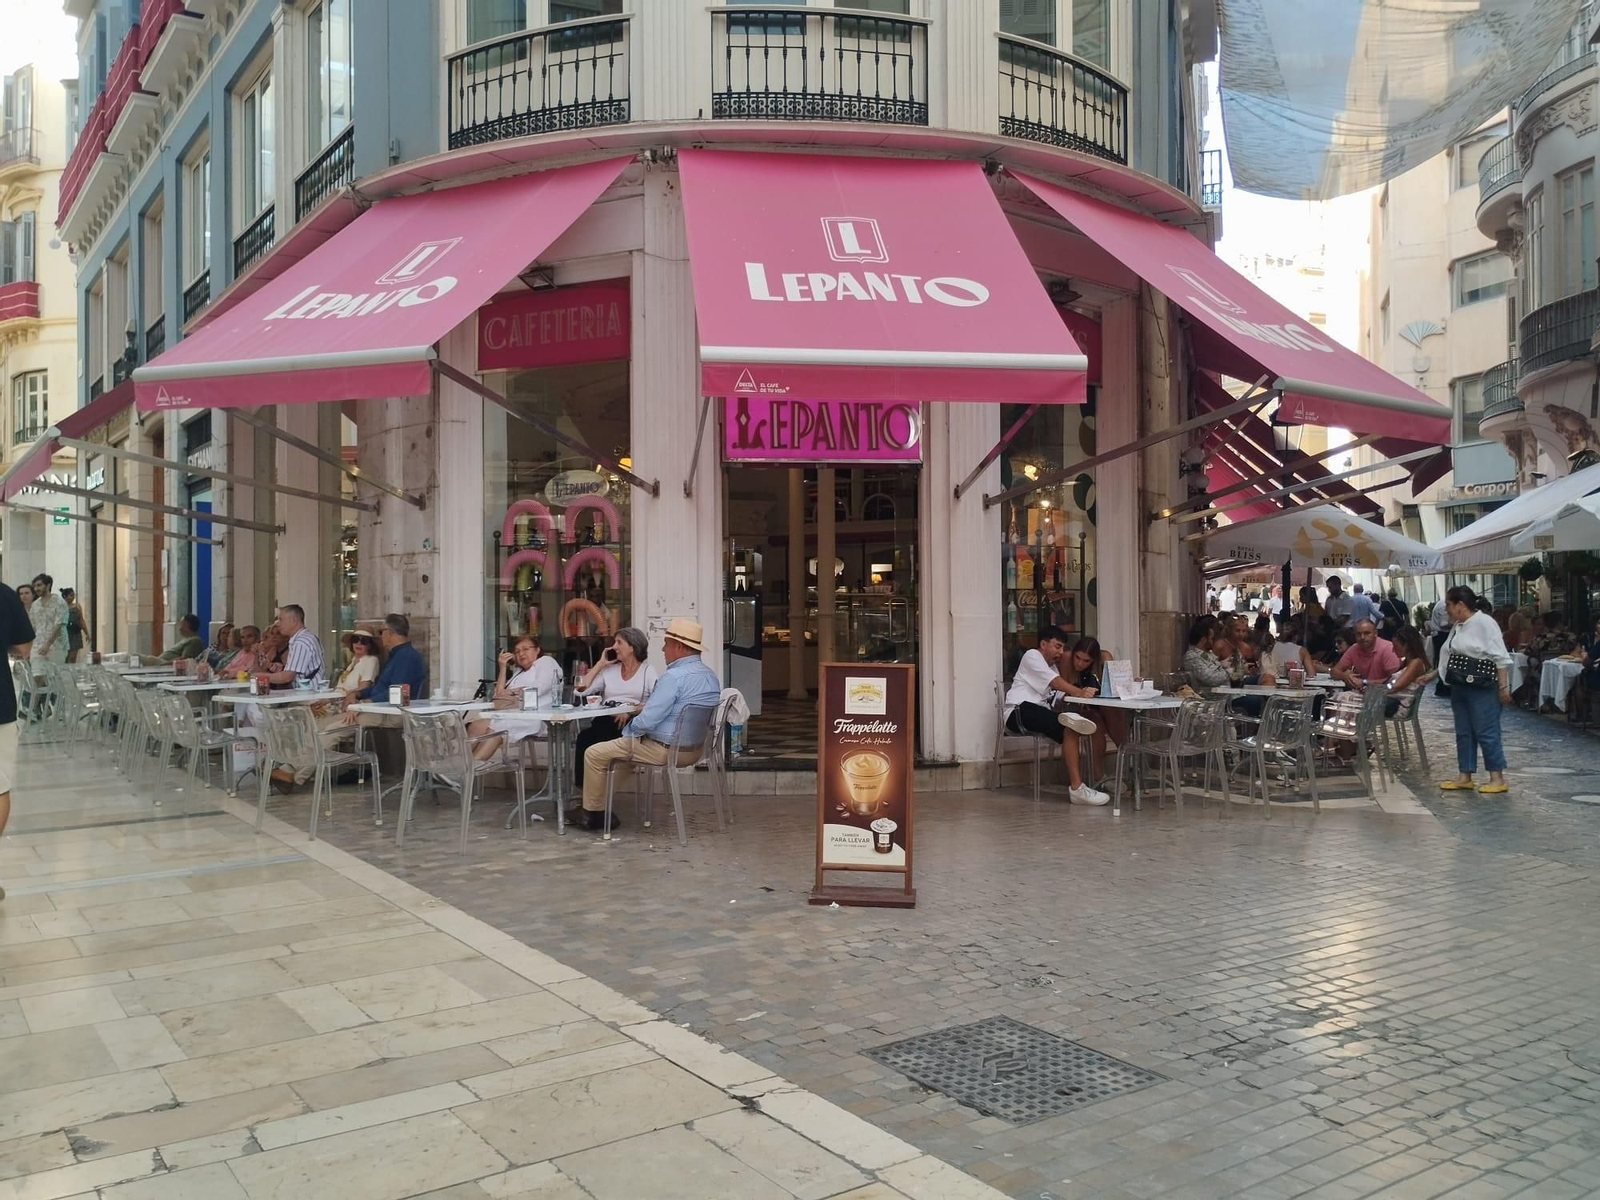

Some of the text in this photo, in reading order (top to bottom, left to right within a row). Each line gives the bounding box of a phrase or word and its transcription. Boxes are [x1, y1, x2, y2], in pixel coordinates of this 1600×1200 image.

[262, 276, 459, 321] LEPANTO
[744, 262, 990, 307] LEPANTO
[483, 302, 622, 350] CAFETERIA
[731, 396, 922, 451] LEPANTO
[1229, 550, 1262, 561] BLISS
[1322, 557, 1361, 566] BLISS
[833, 718, 898, 736] Frappélatte
